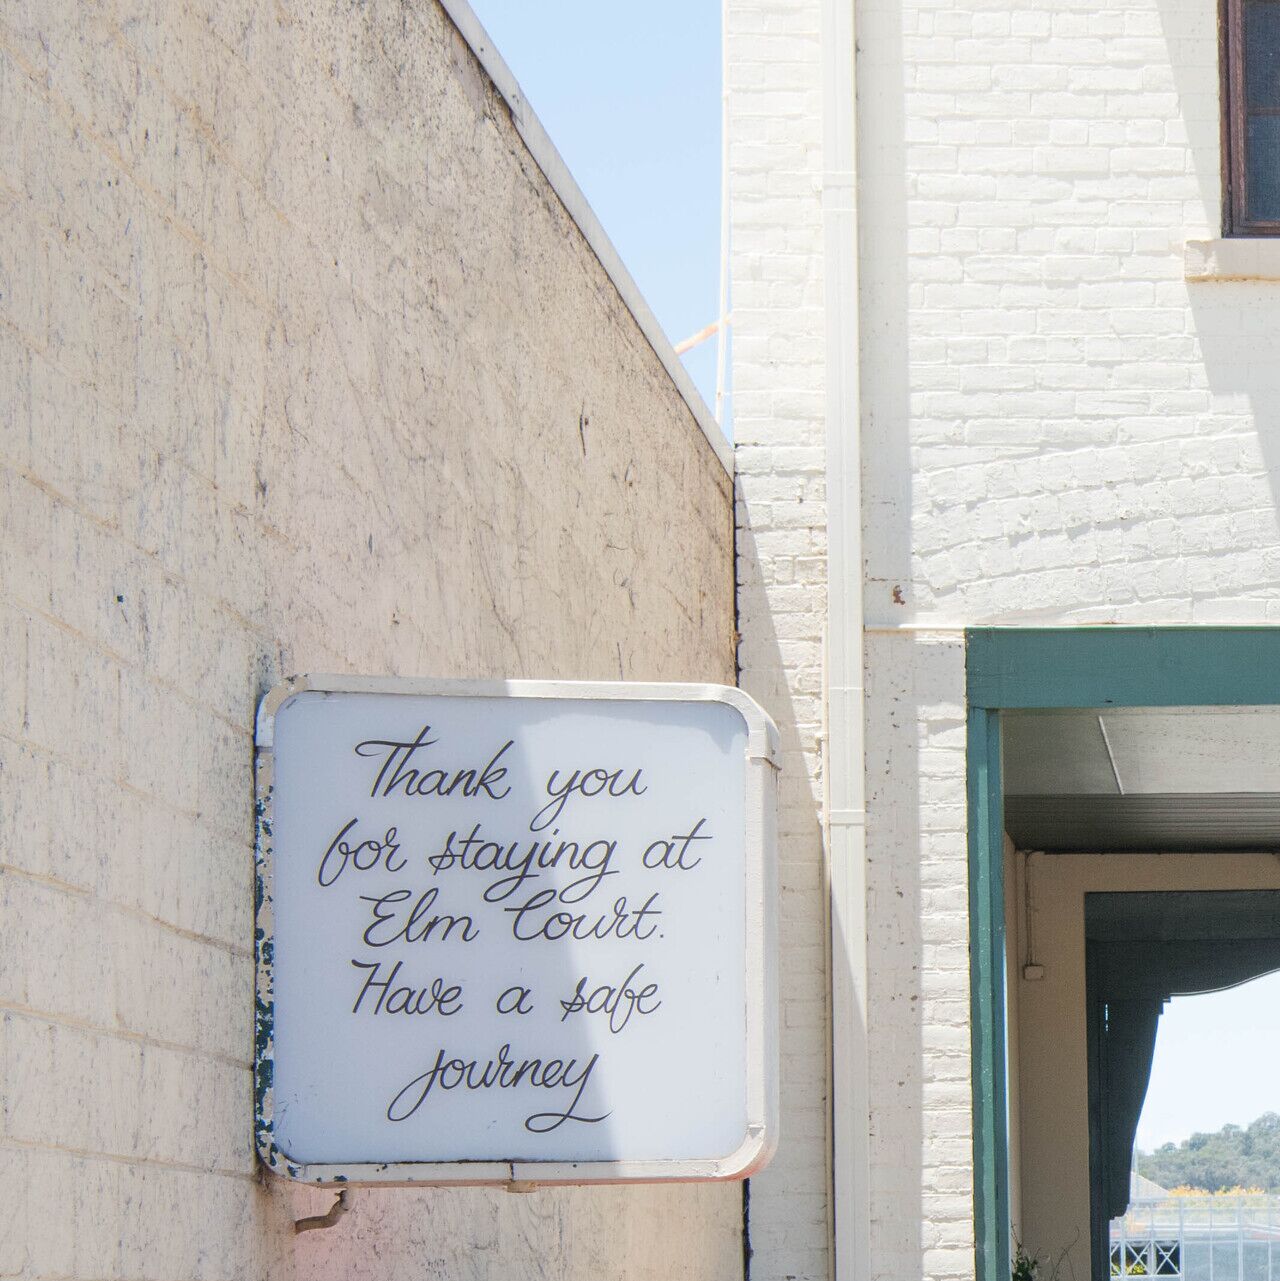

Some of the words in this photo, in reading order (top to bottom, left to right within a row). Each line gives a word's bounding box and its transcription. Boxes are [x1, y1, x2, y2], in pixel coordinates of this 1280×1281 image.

[354, 725, 515, 801] Thank
[529, 767, 648, 832] you
[318, 818, 408, 887] for
[428, 824, 620, 903] staying
[642, 818, 713, 871] at
[360, 889, 480, 948] Elm
[504, 889, 665, 942] Court.
[351, 960, 464, 1016] Have
[496, 984, 533, 1016] a
[560, 963, 662, 1034] safe
